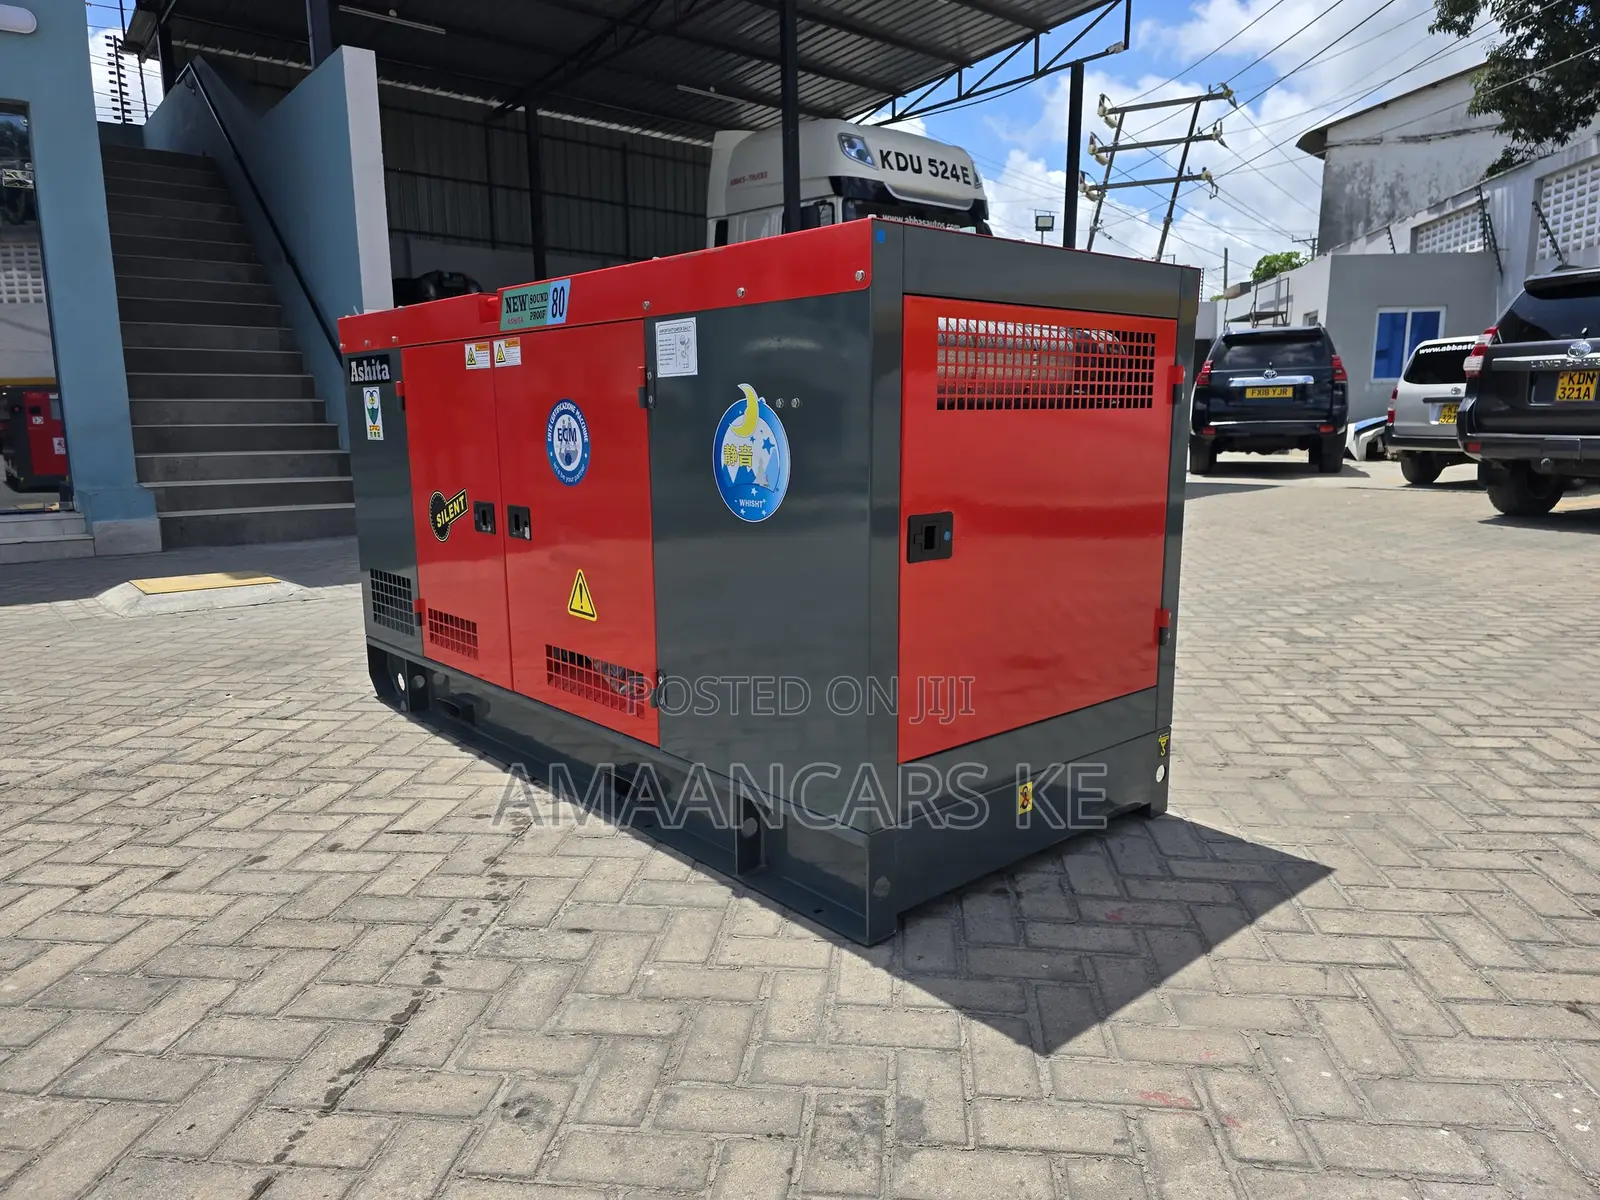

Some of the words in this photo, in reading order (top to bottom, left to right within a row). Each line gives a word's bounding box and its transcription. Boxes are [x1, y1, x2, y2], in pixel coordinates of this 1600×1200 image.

[879, 149, 923, 175] KDU
[928, 157, 972, 186] 524E
[505, 293, 529, 313] NEW
[529, 292, 548, 304] SOUND
[551, 286, 565, 318] 80
[529, 309, 546, 320] PROOF
[350, 359, 390, 382] Ashita
[1531, 359, 1561, 369] LAND
[1567, 372, 1596, 386] KDN
[1251, 389, 1270, 397] FX18
[1272, 388, 1288, 396] YJR
[1558, 387, 1591, 400] 321A
[557, 428, 577, 442] ECM
[724, 444, 753, 468] 静音
[739, 499, 763, 508] WHISHT
[436, 495, 465, 528] SILENT
